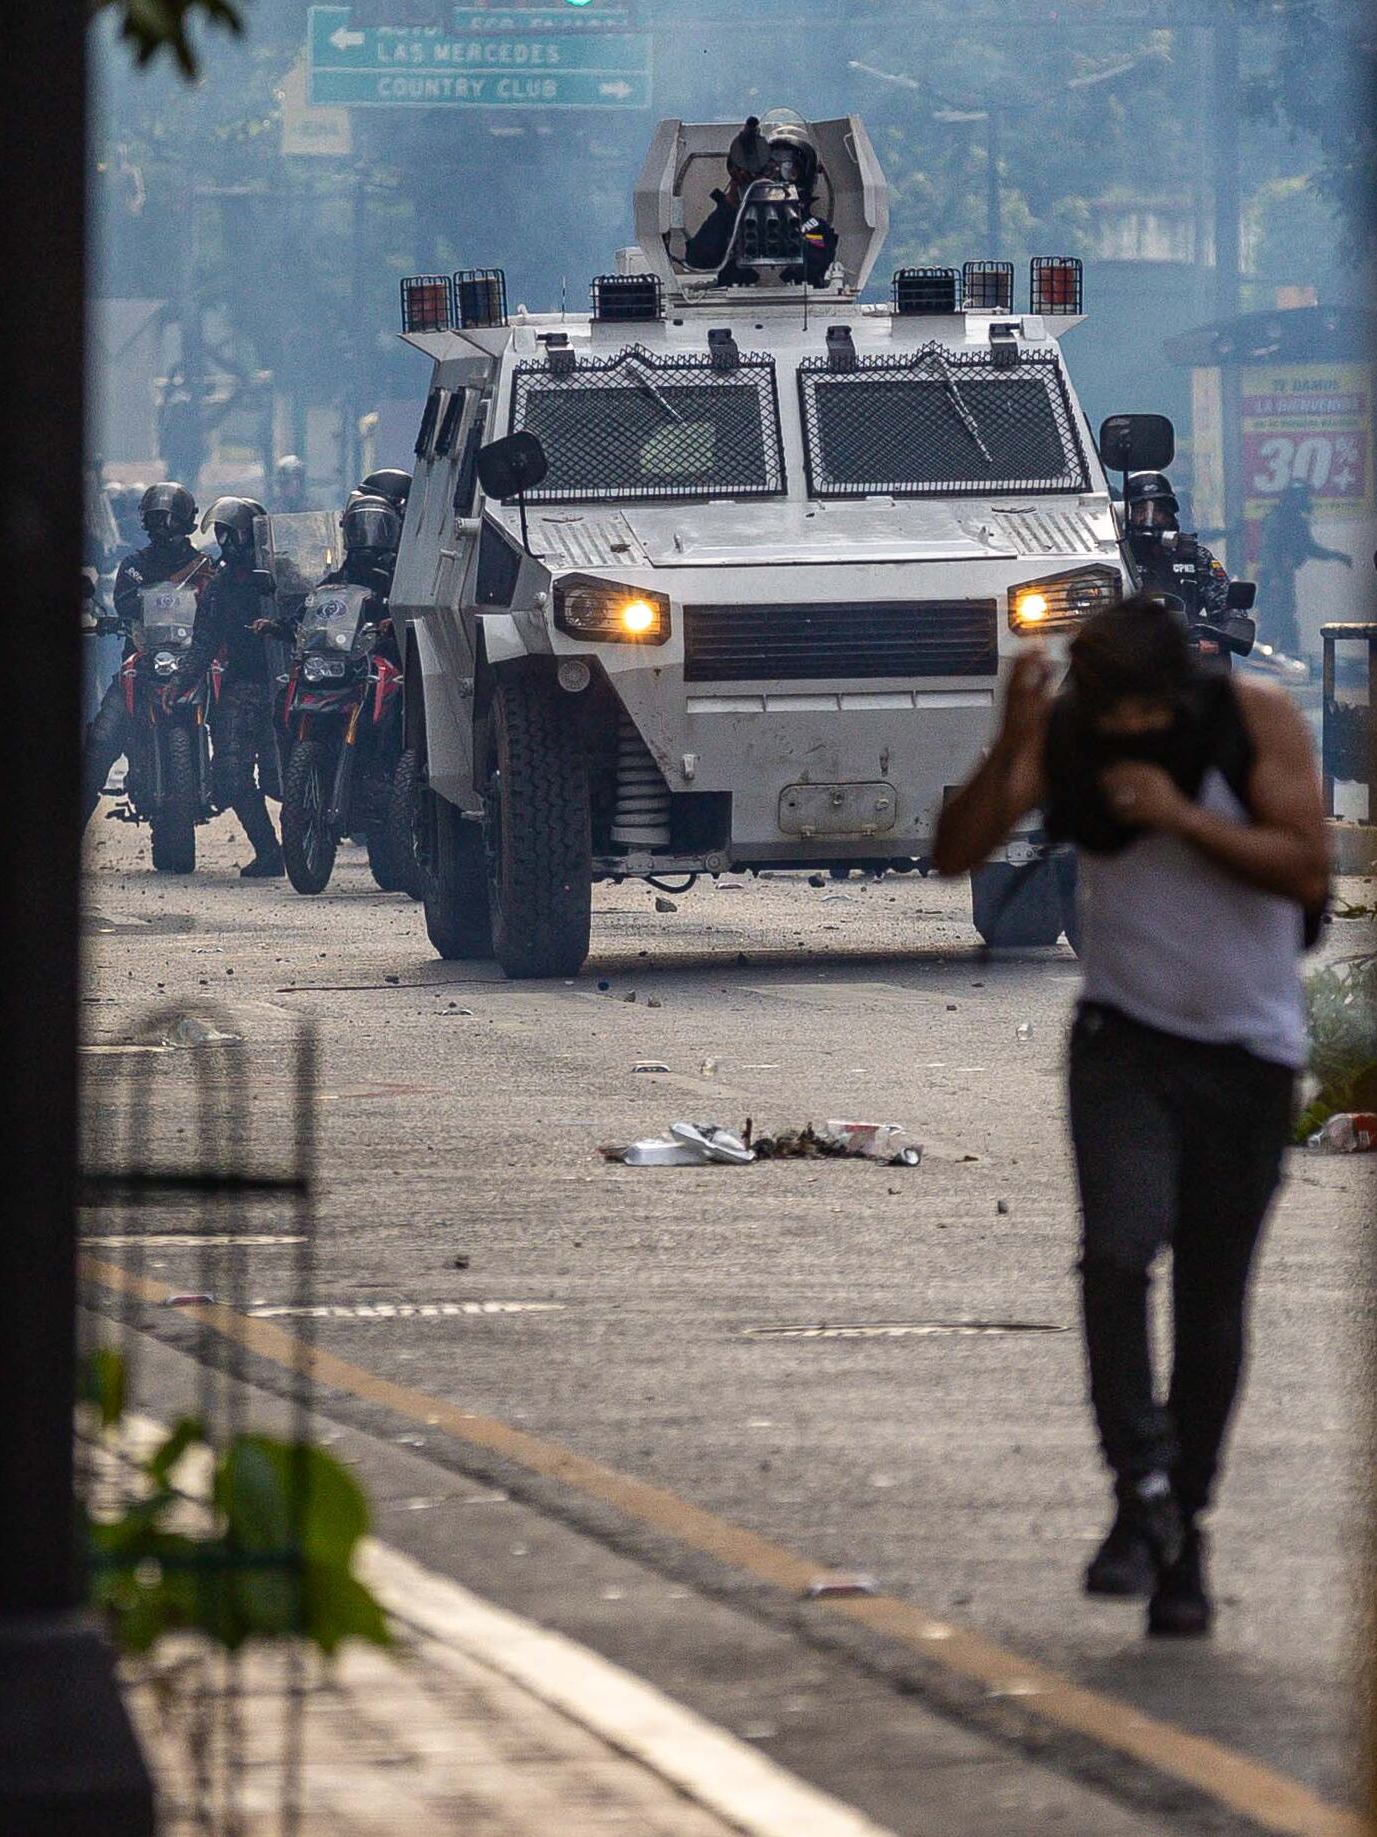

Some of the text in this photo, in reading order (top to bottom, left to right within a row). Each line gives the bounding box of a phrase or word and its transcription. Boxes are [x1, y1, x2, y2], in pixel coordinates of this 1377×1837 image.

[377, 43, 559, 63] LAS MERCEDES
[377, 78, 558, 97] COUNTRY CLUB
